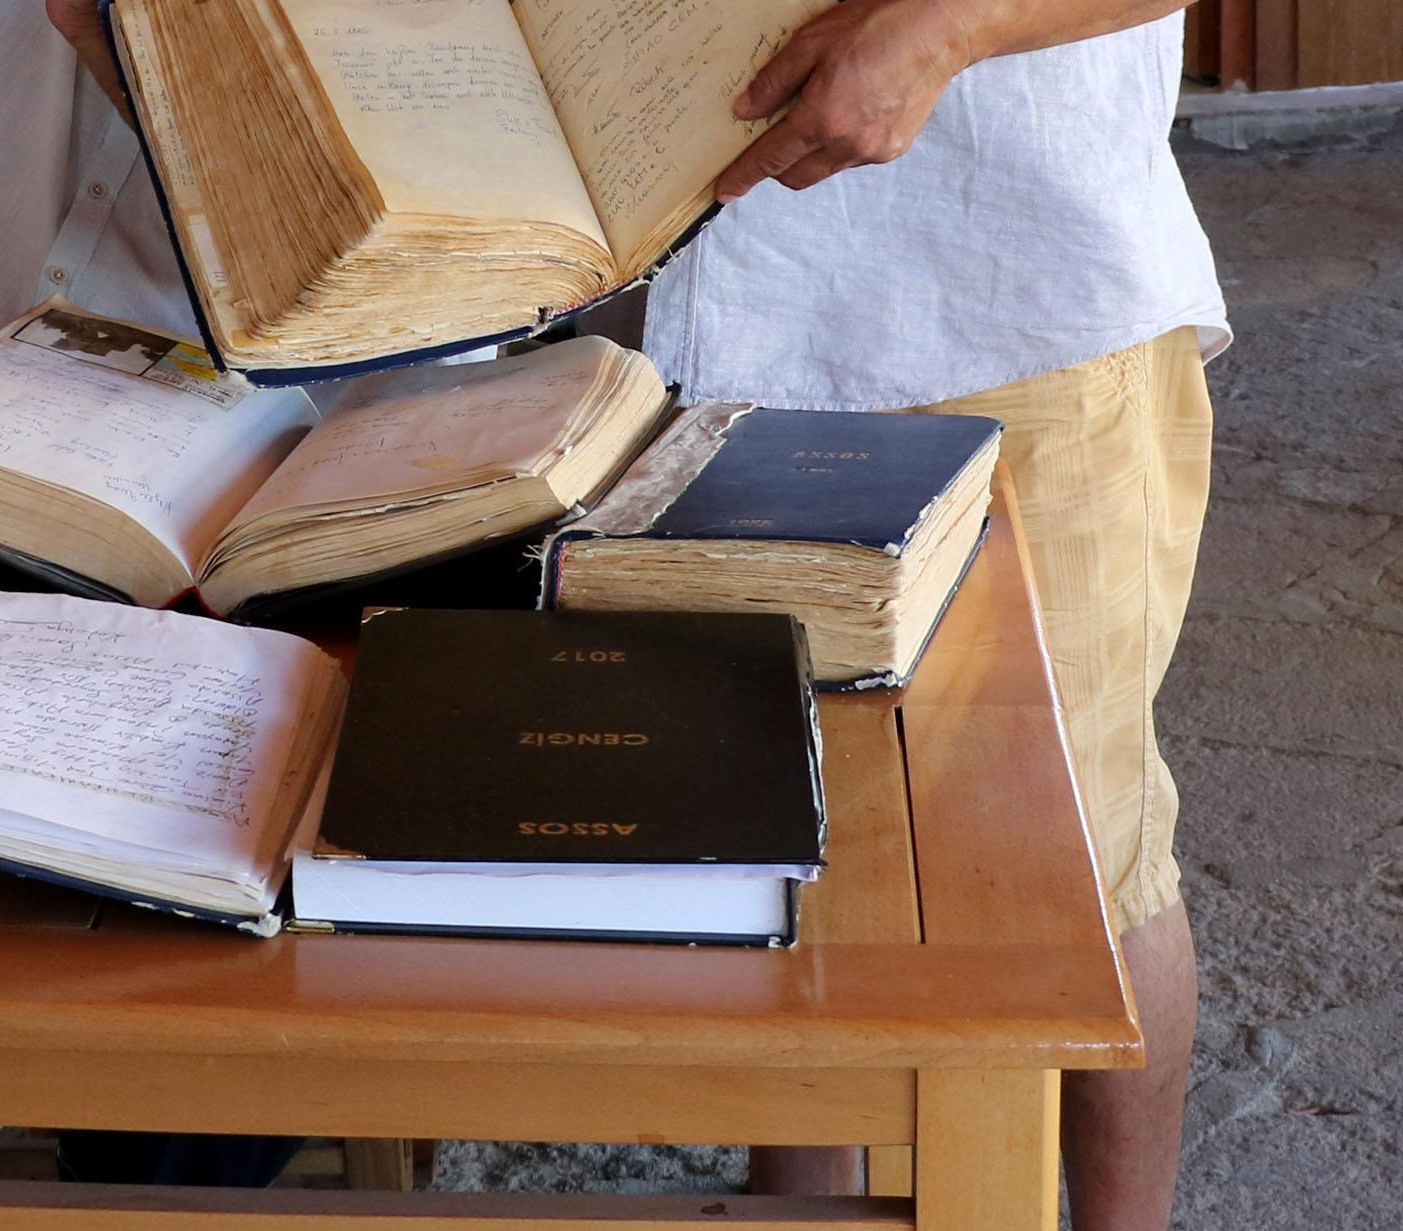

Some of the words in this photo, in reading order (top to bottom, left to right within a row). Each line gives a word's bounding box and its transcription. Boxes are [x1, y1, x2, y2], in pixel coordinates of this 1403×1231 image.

[550, 651, 627, 662] 2017
[518, 731, 651, 746] CENGİZ
[518, 822, 639, 836] ASSOS
